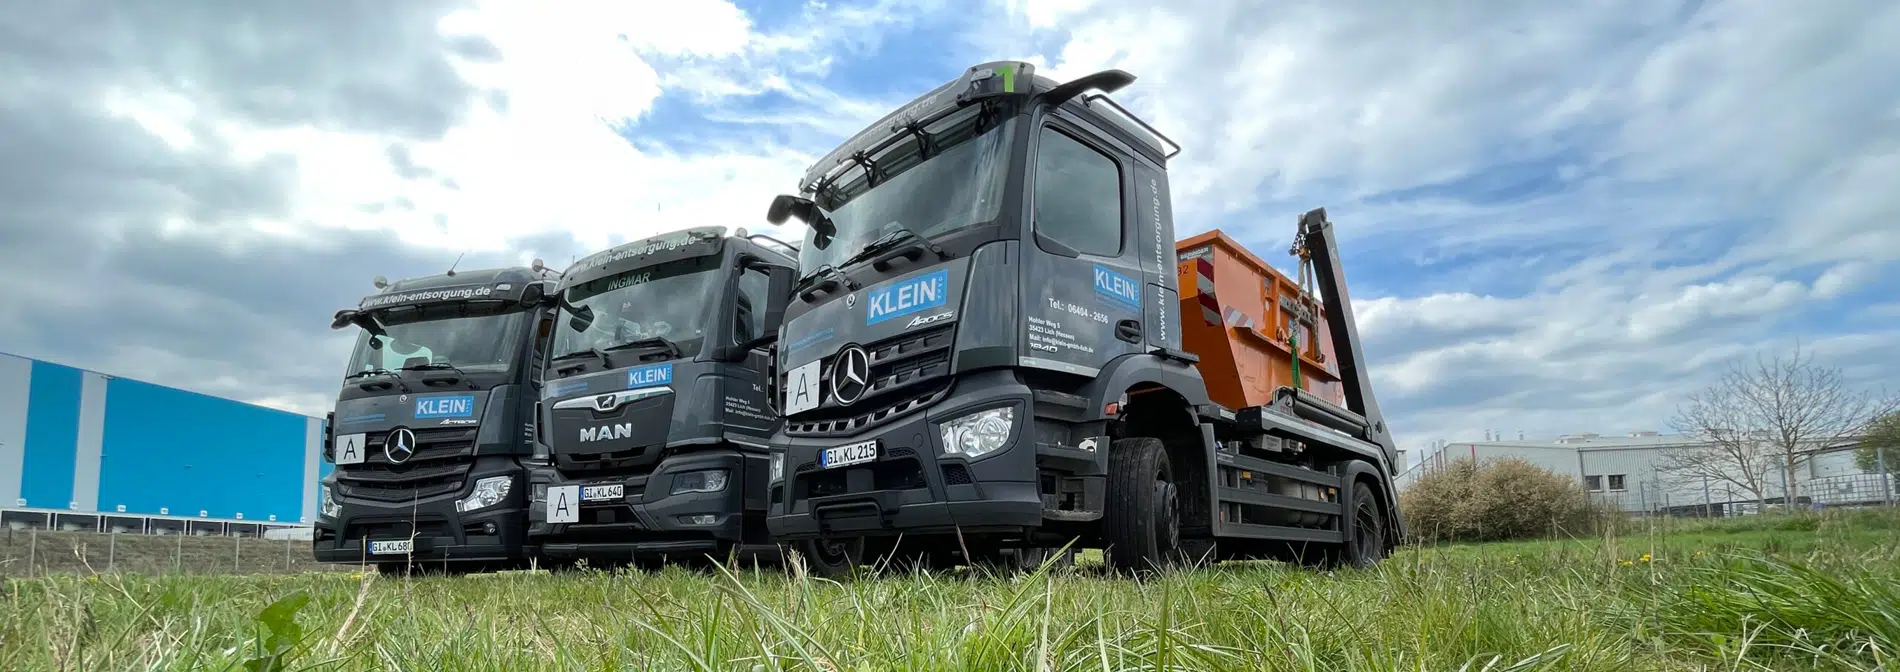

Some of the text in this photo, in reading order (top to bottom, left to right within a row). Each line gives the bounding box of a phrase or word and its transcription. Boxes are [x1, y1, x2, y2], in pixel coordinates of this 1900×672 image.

[995, 67, 1014, 93] 1
[1150, 178, 1166, 341] www.klein-entsorgung.de
[607, 271, 651, 291] INGMAR
[1095, 267, 1135, 301] KLEIN
[869, 278, 937, 319] KLEIN
[1049, 298, 1064, 311] Tel.:
[1068, 304, 1088, 317] 06404
[629, 367, 667, 386] KLEIN
[795, 373, 809, 406] A
[416, 399, 466, 415] KLEIN
[579, 422, 633, 443] MAN
[343, 437, 357, 460] A
[827, 443, 876, 464] GI KL 215
[584, 485, 622, 498] GI KL 640
[556, 492, 570, 517] A
[372, 542, 382, 552] GI
[386, 542, 397, 551] KL
